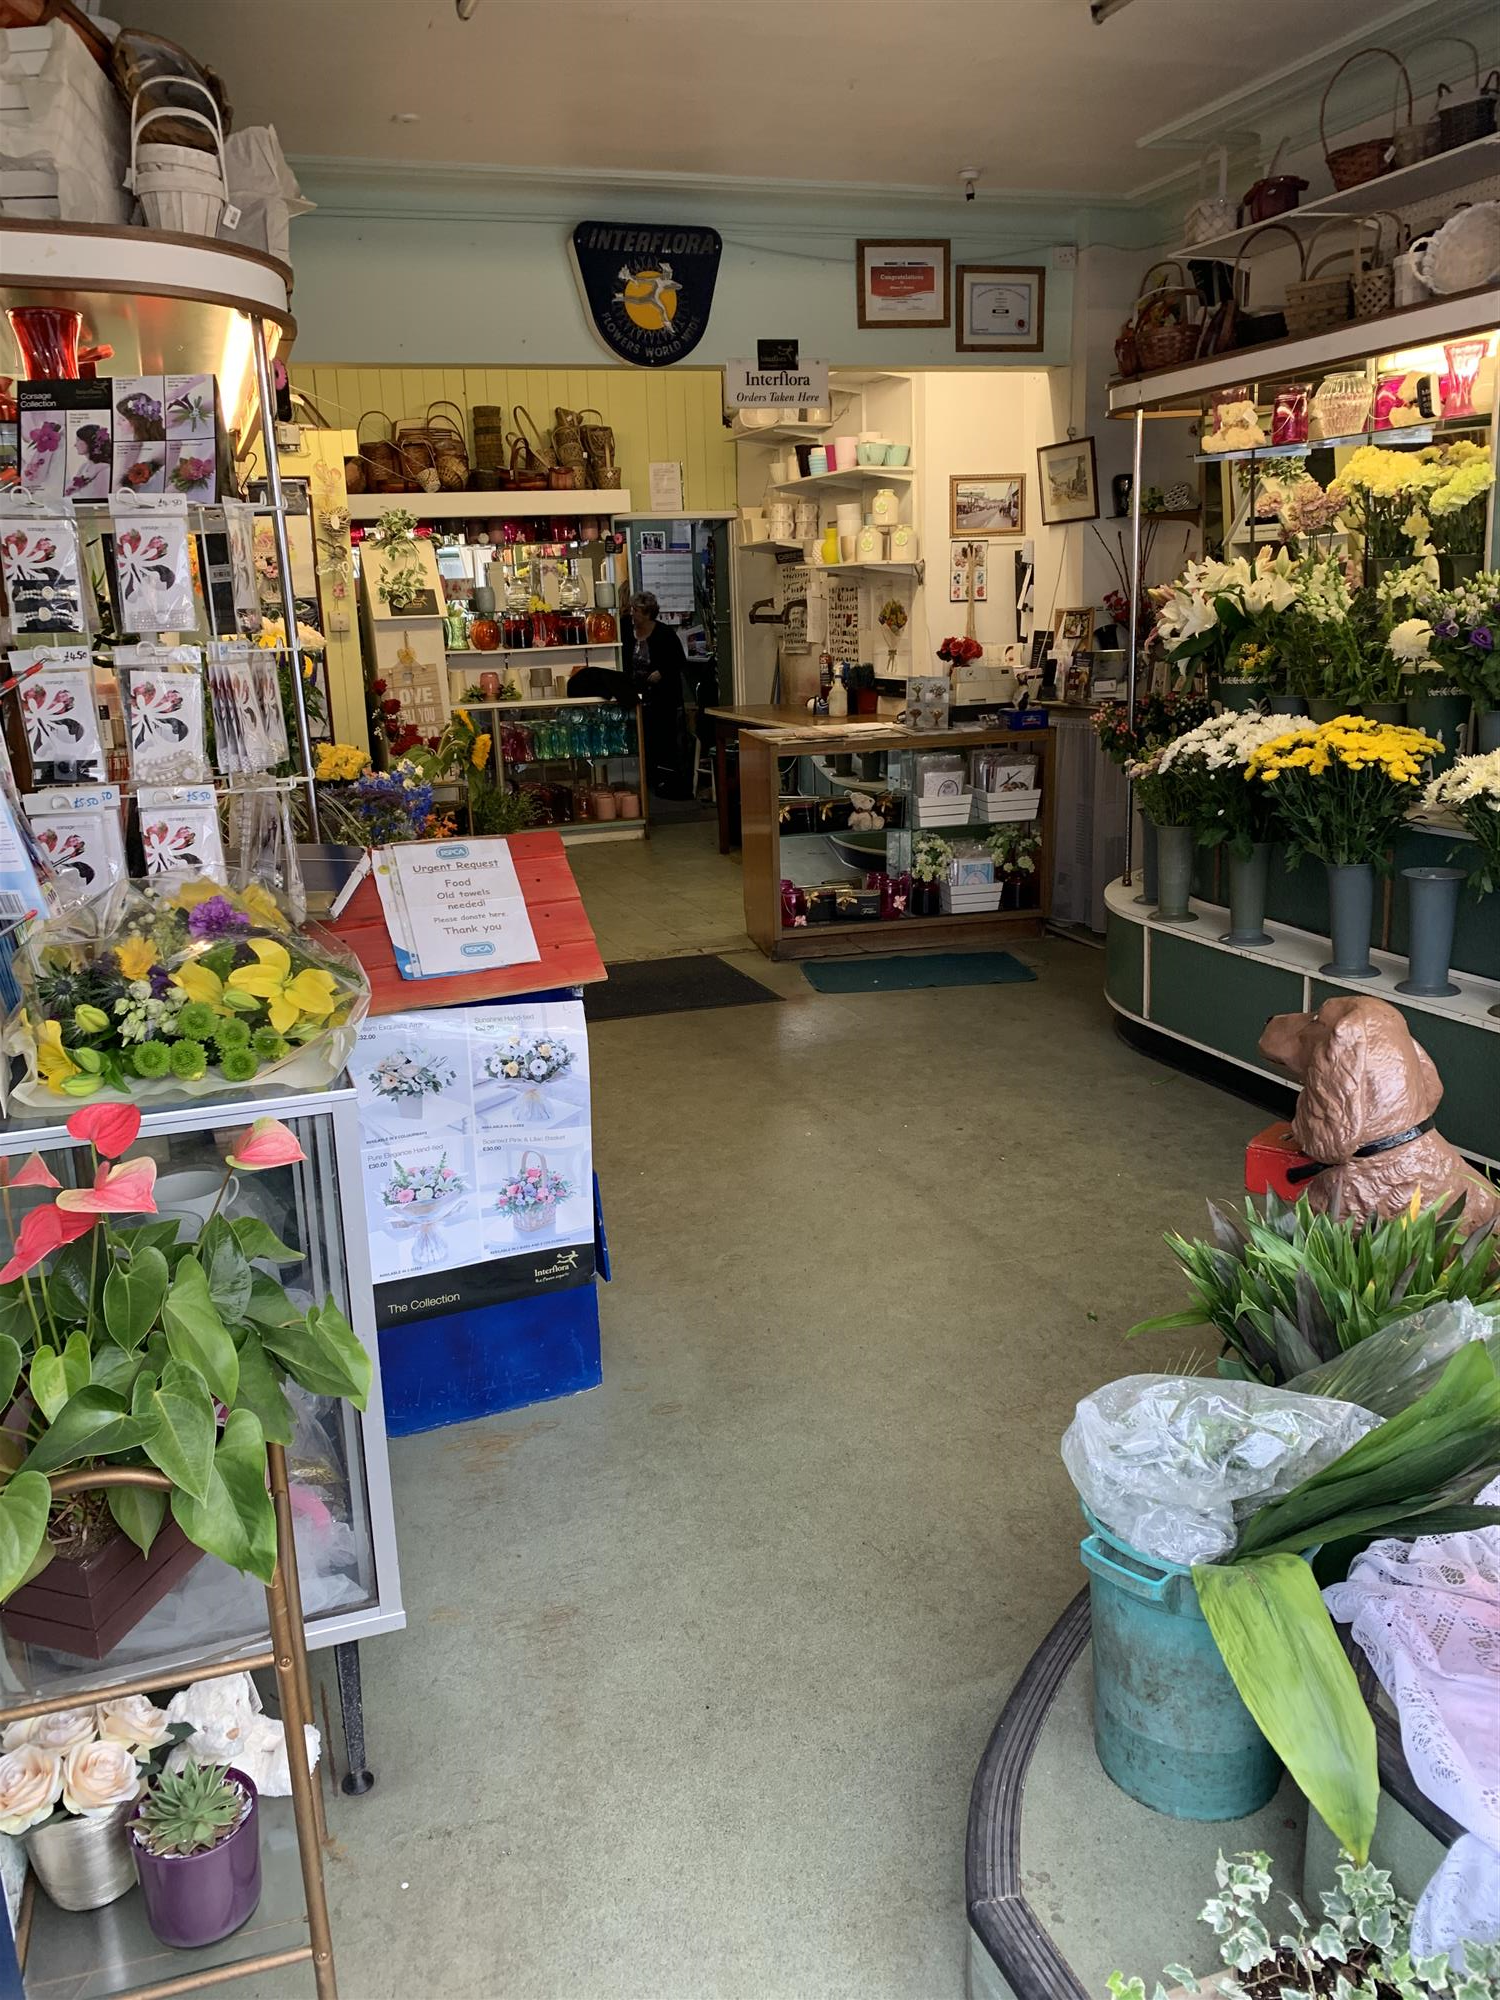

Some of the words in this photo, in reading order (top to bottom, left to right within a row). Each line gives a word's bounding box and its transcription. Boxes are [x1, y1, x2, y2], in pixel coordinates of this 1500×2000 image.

[588, 228, 715, 255] INTERFLORA
[602, 312, 641, 354] FLOWERS
[645, 340, 681, 357] WORLD
[681, 316, 700, 341] WIDE
[745, 371, 810, 386] Interflora
[20, 393, 52, 401] Corsage
[736, 392, 767, 402] Orders
[770, 392, 795, 402] Taken
[798, 392, 819, 402] Here
[420, 707, 435, 723] YOU
[187, 790, 211, 801] £5.50
[440, 847, 465, 857] RSPCA
[413, 864, 451, 873] Urgent
[456, 860, 499, 870] Request
[445, 878, 471, 887] Food
[437, 892, 455, 900] Old
[459, 889, 490, 897] towels
[448, 900, 486, 910] needed!
[460, 913, 486, 921] donate
[443, 924, 478, 935] Thank
[483, 924, 502, 934] you
[465, 945, 492, 954] RSPCA
[475, 1015, 503, 1024] Sunshine
[368, 1154, 383, 1163] Pure
[384, 1150, 412, 1161] Elegance
[535, 1264, 569, 1277] Interflora
[388, 1304, 408, 1314] The
[411, 1293, 460, 1310] Collection
